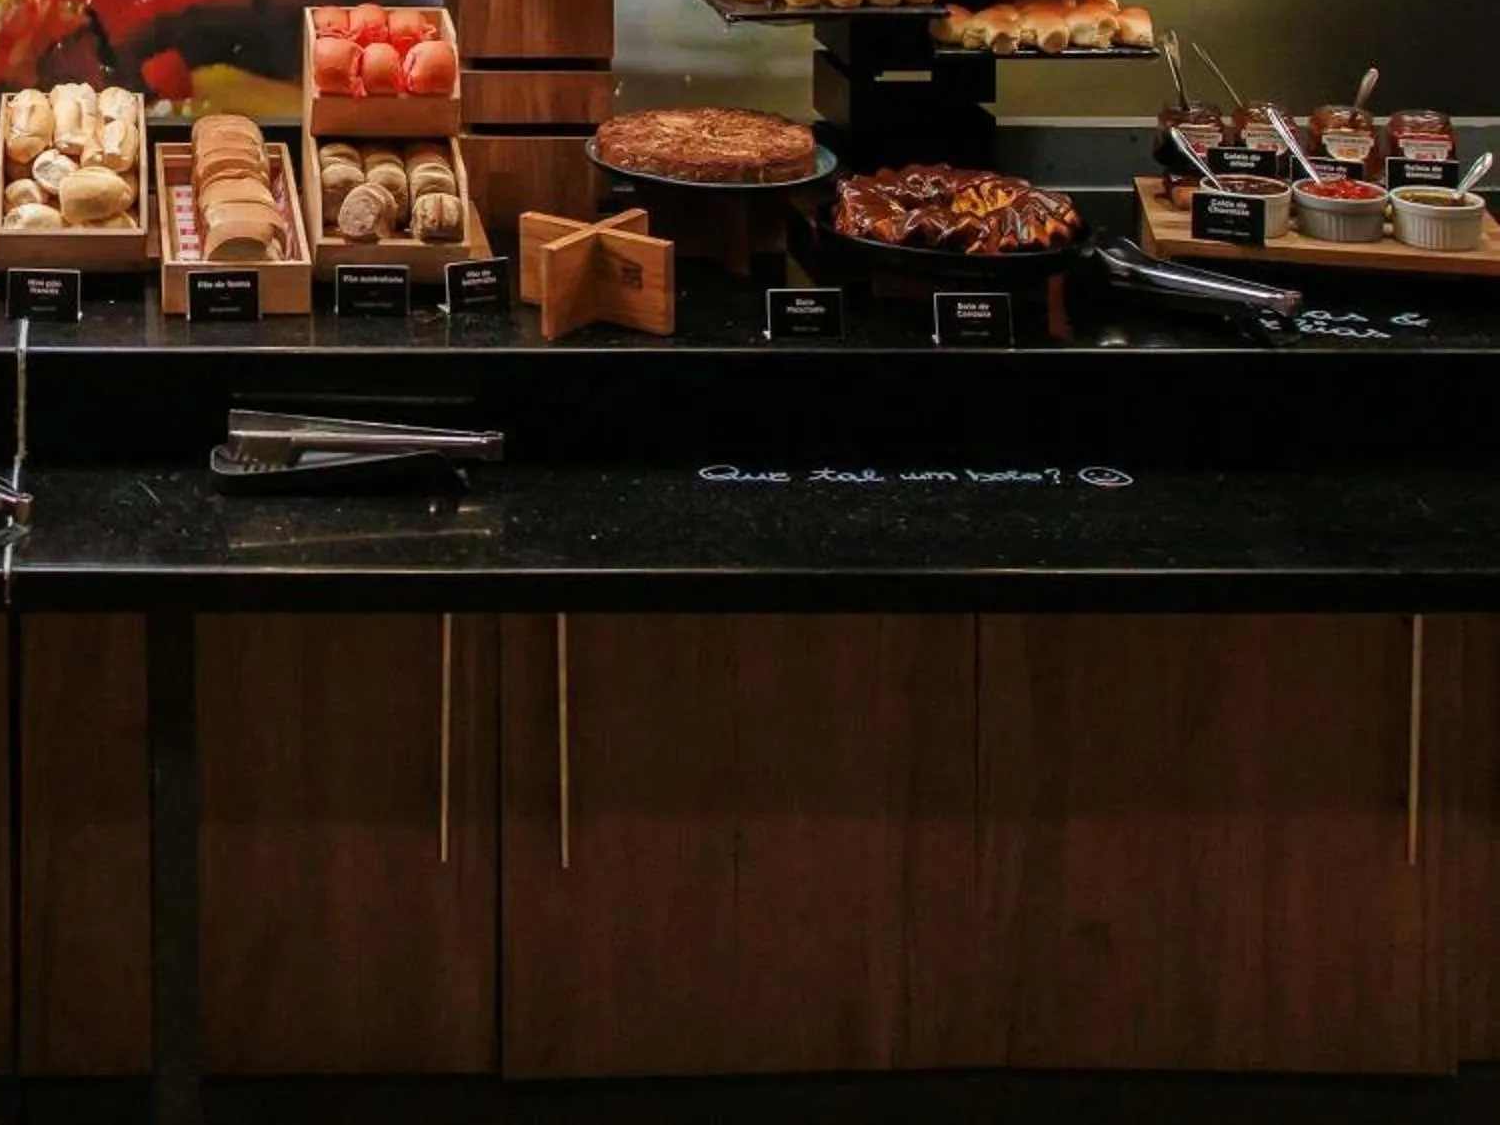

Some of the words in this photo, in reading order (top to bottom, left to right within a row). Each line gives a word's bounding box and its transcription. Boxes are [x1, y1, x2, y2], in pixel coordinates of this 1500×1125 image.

[698, 464, 791, 481] Que
[808, 467, 885, 482] tal
[900, 470, 958, 481] um
